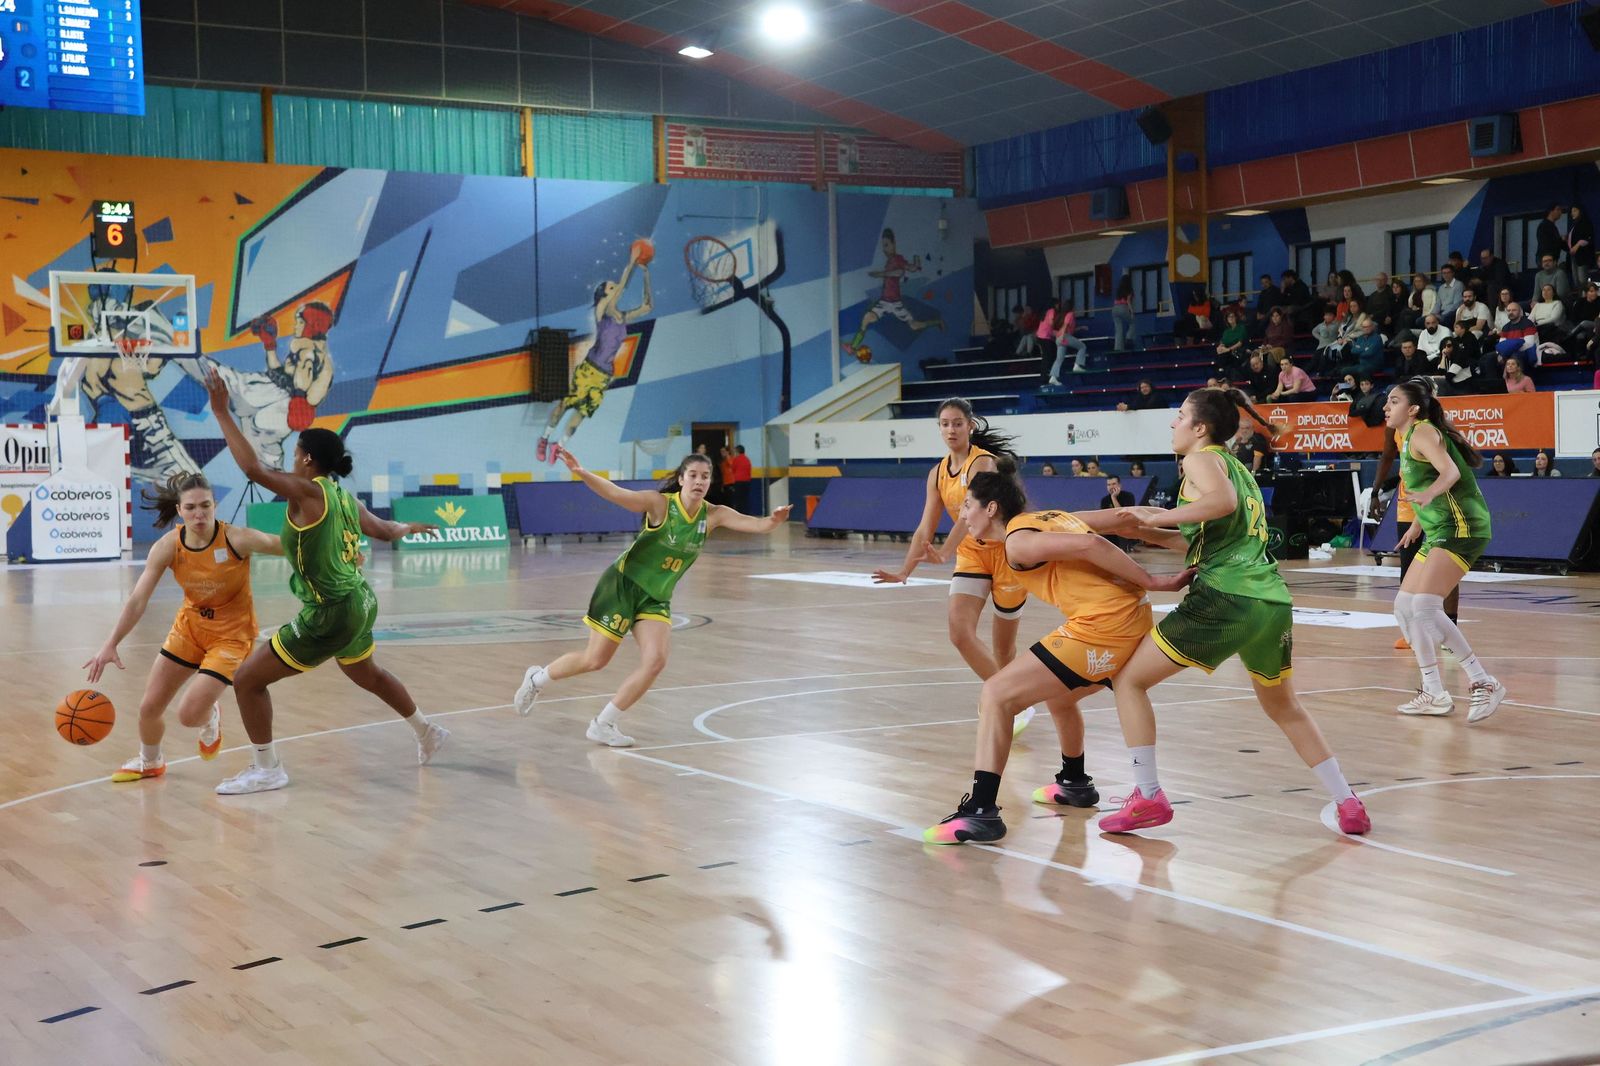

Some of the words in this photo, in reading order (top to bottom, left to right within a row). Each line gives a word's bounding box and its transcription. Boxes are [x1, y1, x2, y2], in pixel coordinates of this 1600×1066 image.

[127, 47, 134, 56] 2
[20, 70, 30, 87] 2
[107, 223, 123, 246] 6
[1294, 433, 1353, 450] ZAMORA
[1459, 429, 1509, 447] MORA
[50, 490, 112, 500] cobreros
[55, 512, 110, 521] cobreros
[60, 530, 103, 539] cobreros
[446, 526, 506, 542] RURAL
[661, 556, 683, 573] 30
[610, 613, 630, 633] 30
